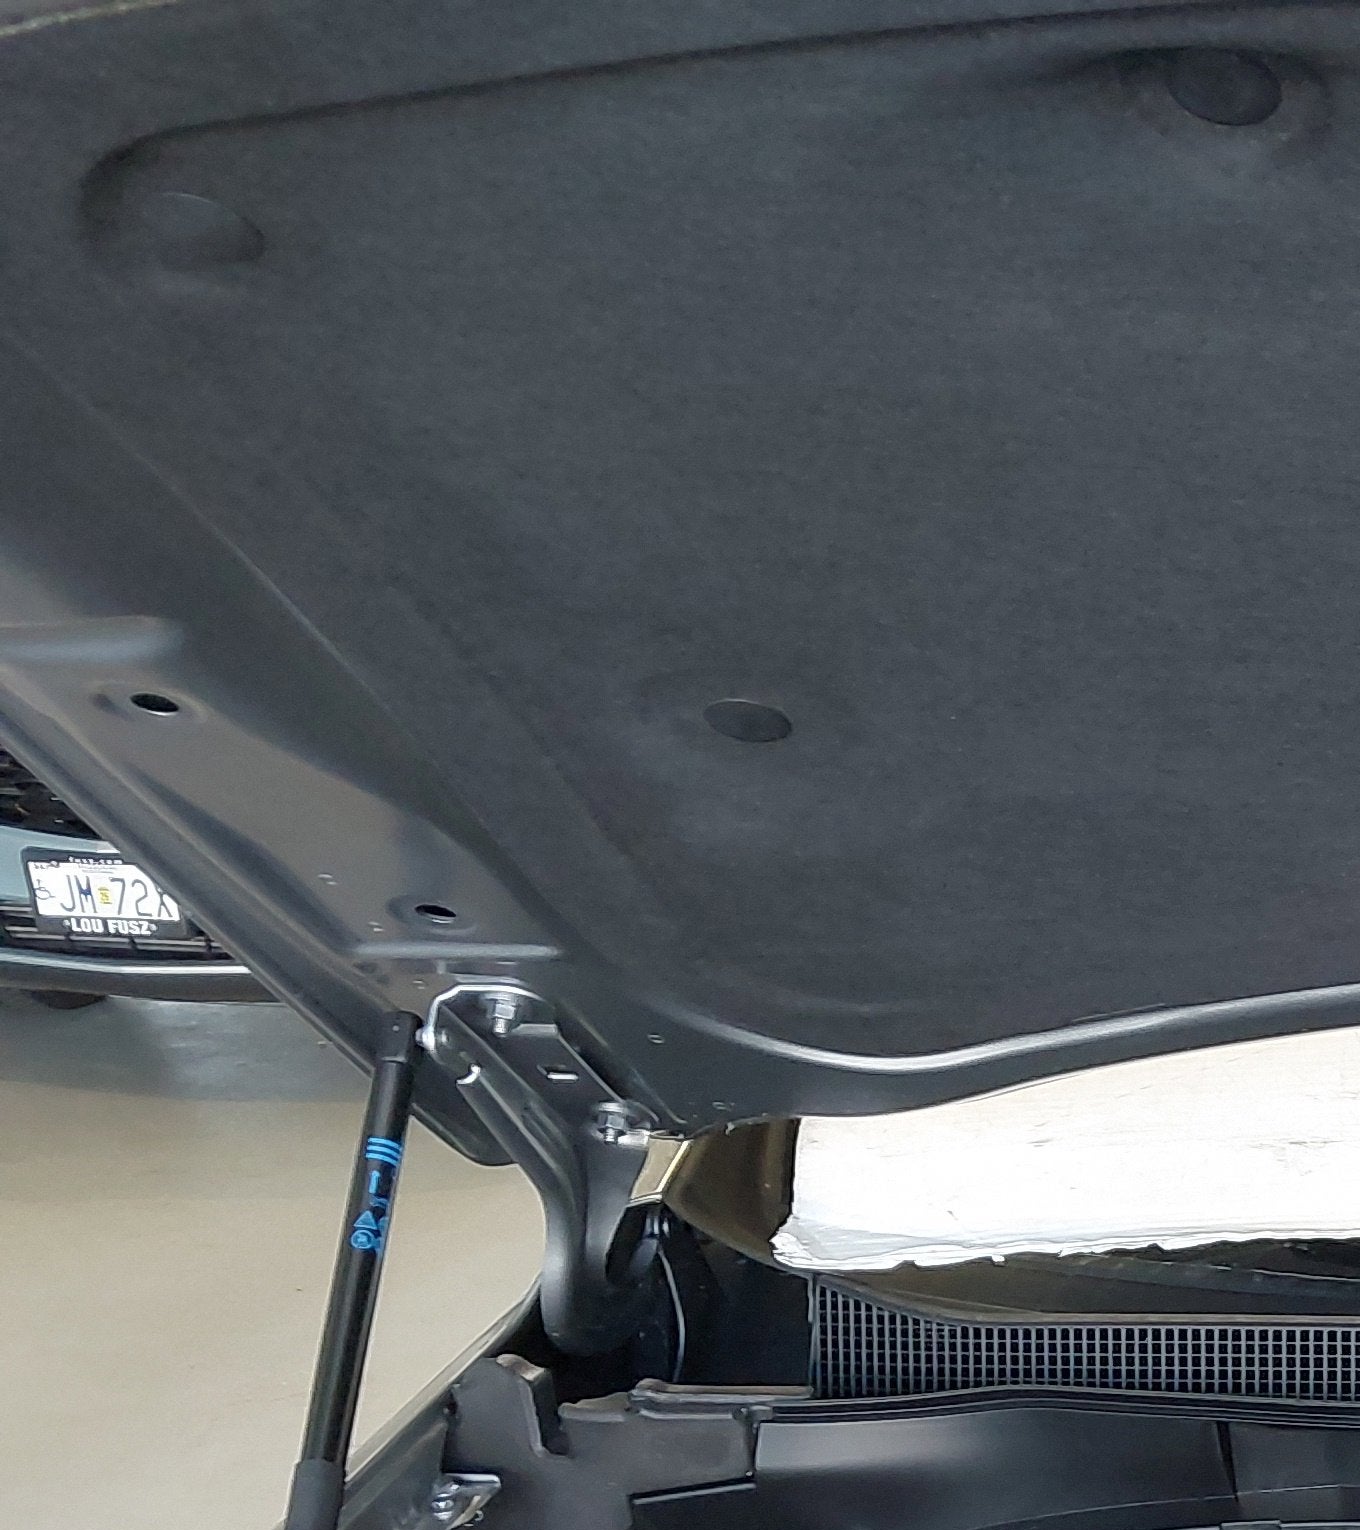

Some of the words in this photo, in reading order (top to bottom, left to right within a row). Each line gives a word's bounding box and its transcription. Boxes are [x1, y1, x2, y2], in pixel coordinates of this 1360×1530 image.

[60, 874, 97, 914] JM
[70, 917, 105, 934] LOU
[107, 919, 152, 937] FUSZ
